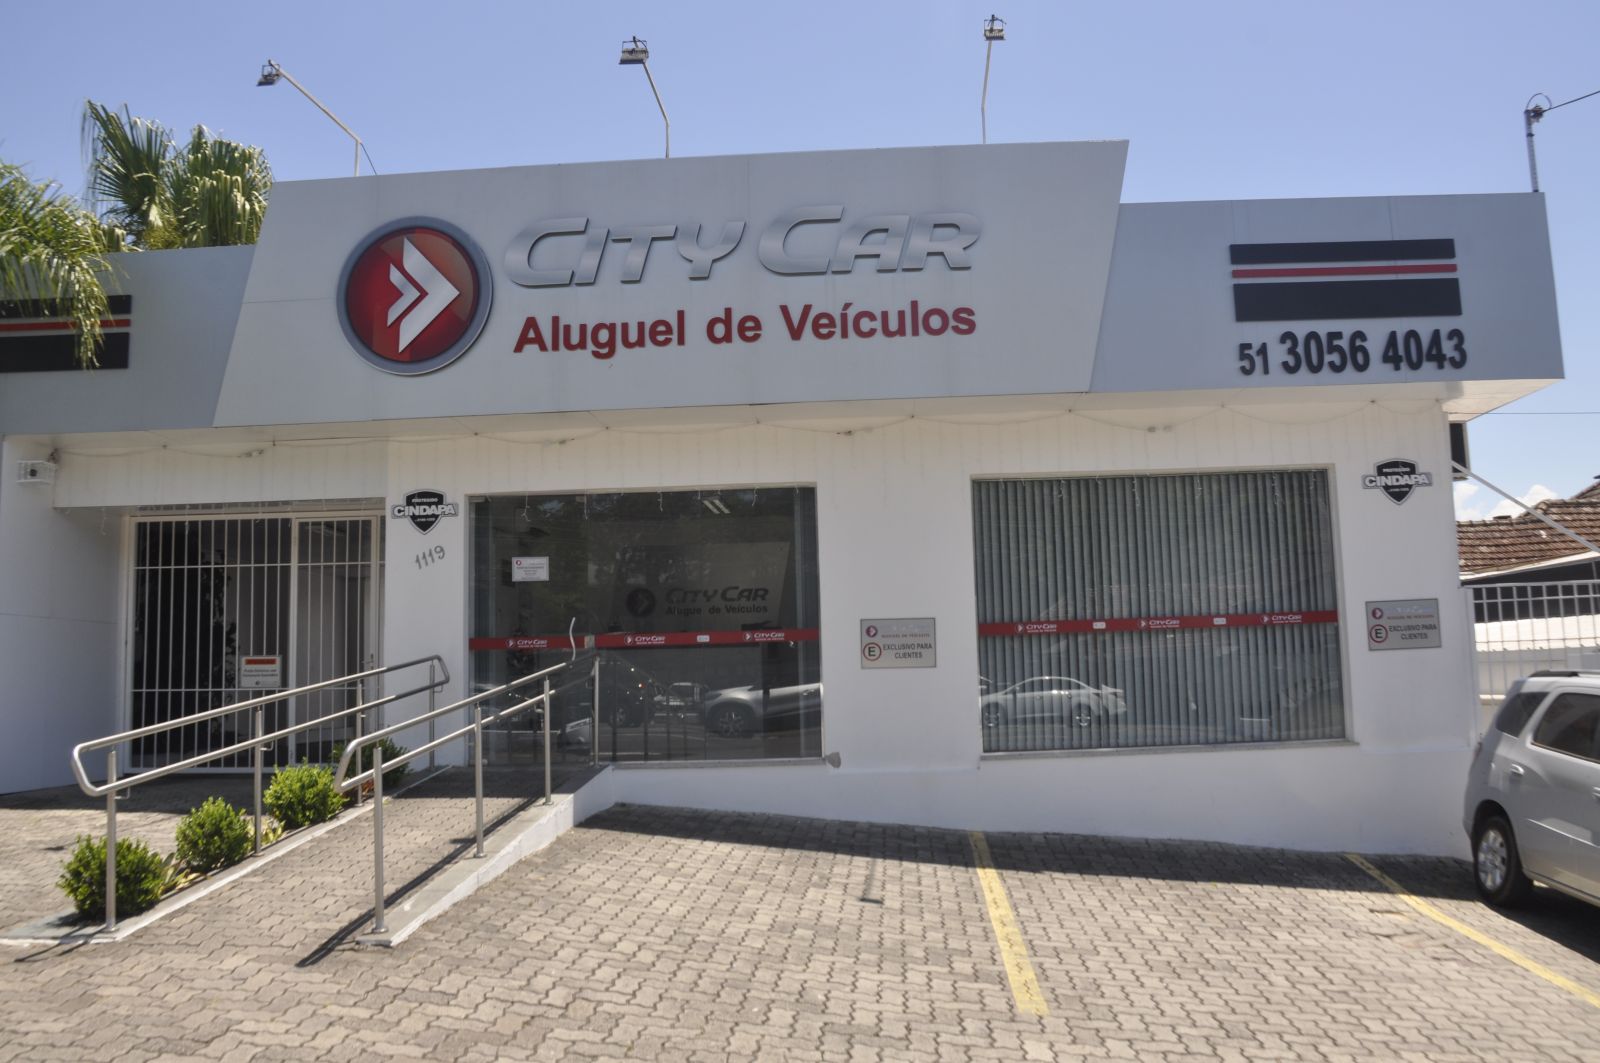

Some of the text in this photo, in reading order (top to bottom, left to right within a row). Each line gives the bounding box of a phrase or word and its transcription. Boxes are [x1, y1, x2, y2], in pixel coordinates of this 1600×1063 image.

[504, 204, 984, 288] CITY CAR
[513, 299, 977, 360] Aluguel de Veículos
[1238, 327, 1468, 376] 51 3056 4043
[1365, 474, 1430, 487] CINDAPA
[393, 504, 456, 517] CINDAPA
[414, 545, 446, 570] 1119
[720, 586, 769, 602] CAR
[1374, 628, 1384, 639] E
[1387, 624, 1421, 632] EXCLUSIVO
[1400, 632, 1428, 640] CLIENTES
[867, 646, 877, 657] E
[882, 642, 933, 651] EXCLUSIVO PARA
[894, 651, 923, 659] CLIENTES
